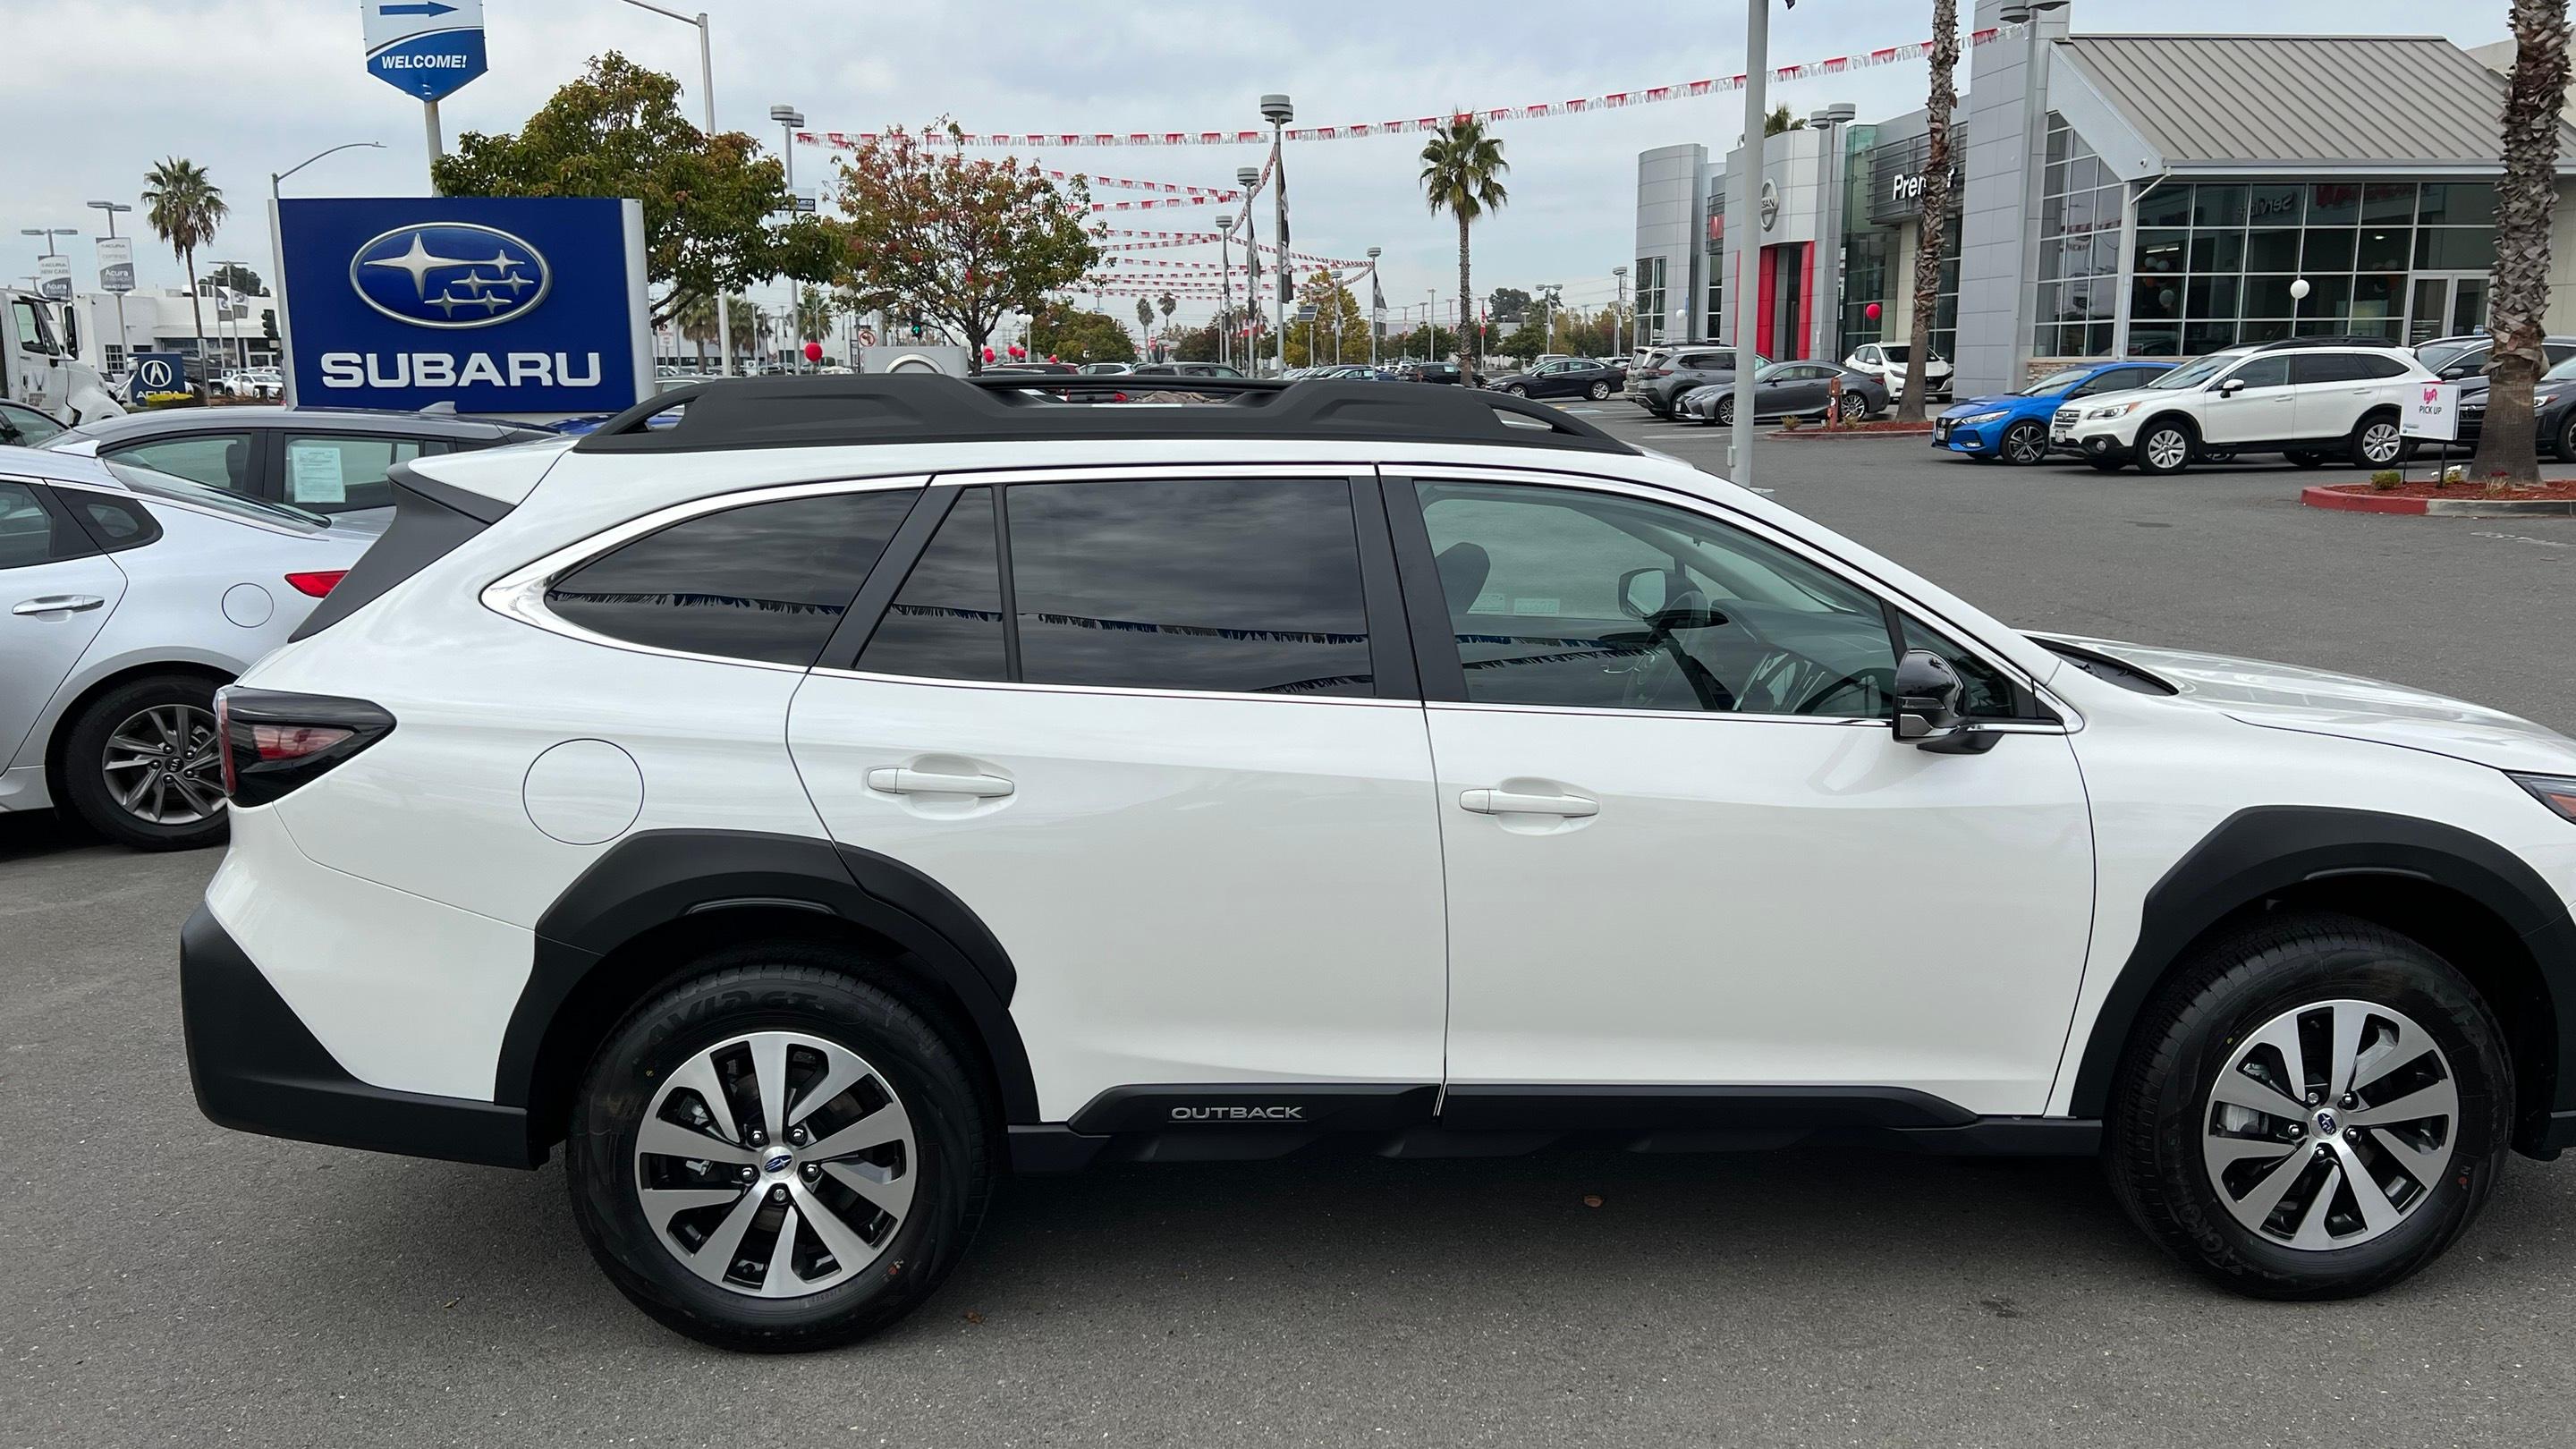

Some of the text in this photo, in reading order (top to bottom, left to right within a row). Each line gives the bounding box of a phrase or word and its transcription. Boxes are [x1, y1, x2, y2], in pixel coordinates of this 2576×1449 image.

[381, 55, 468, 70] WELCOME!
[1893, 166, 1955, 200] Premr
[105, 269, 129, 277] Acura
[321, 352, 602, 388] SUBARU
[2424, 388, 2437, 404] lyft
[2419, 405, 2442, 415] PICK UP
[1171, 1106, 1303, 1119] OUTBACK
